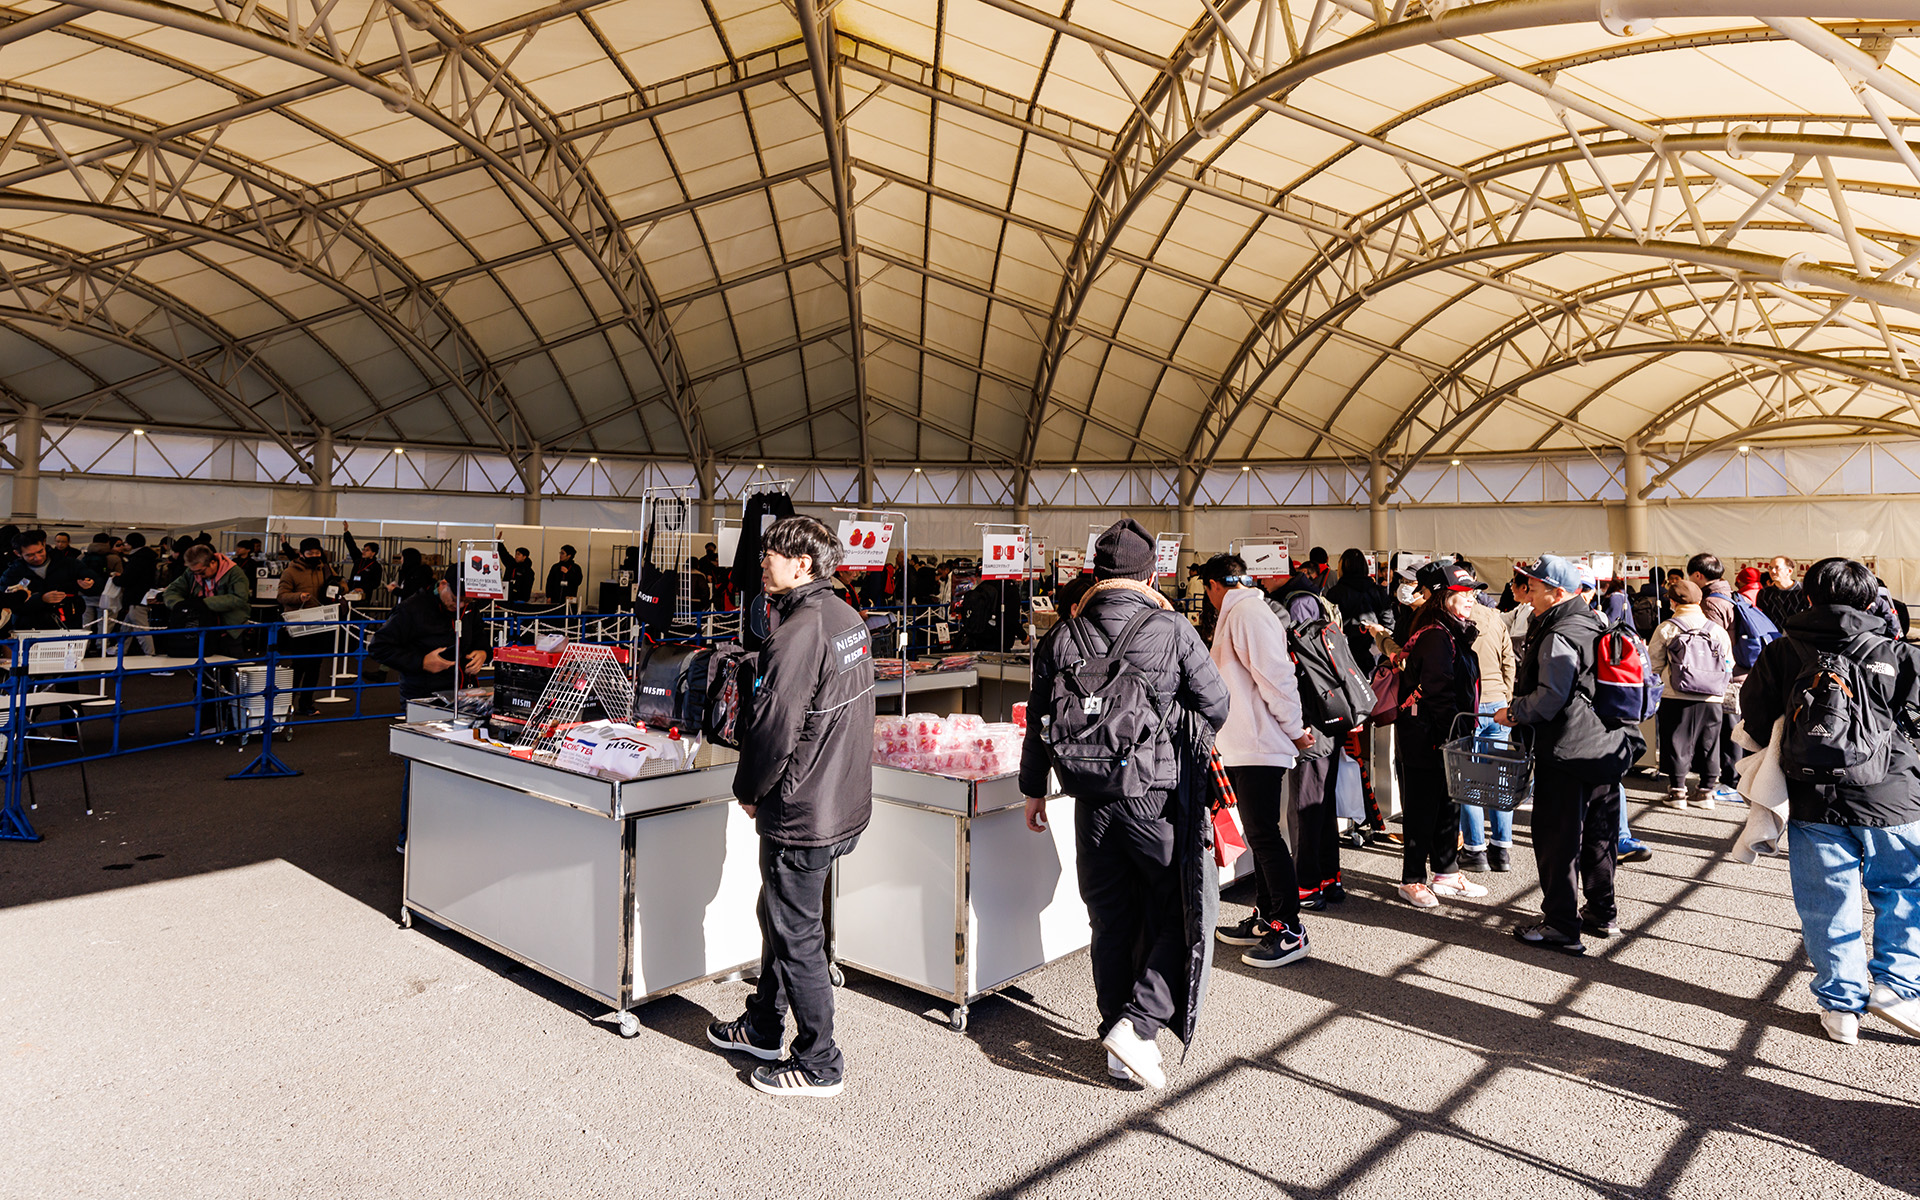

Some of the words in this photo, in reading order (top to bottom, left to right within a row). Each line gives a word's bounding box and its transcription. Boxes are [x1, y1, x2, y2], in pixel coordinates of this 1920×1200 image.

[836, 629, 867, 651] NISSAN
[844, 645, 868, 665] nismo
[643, 686, 672, 697] nismo
[580, 745, 594, 757] TEA
